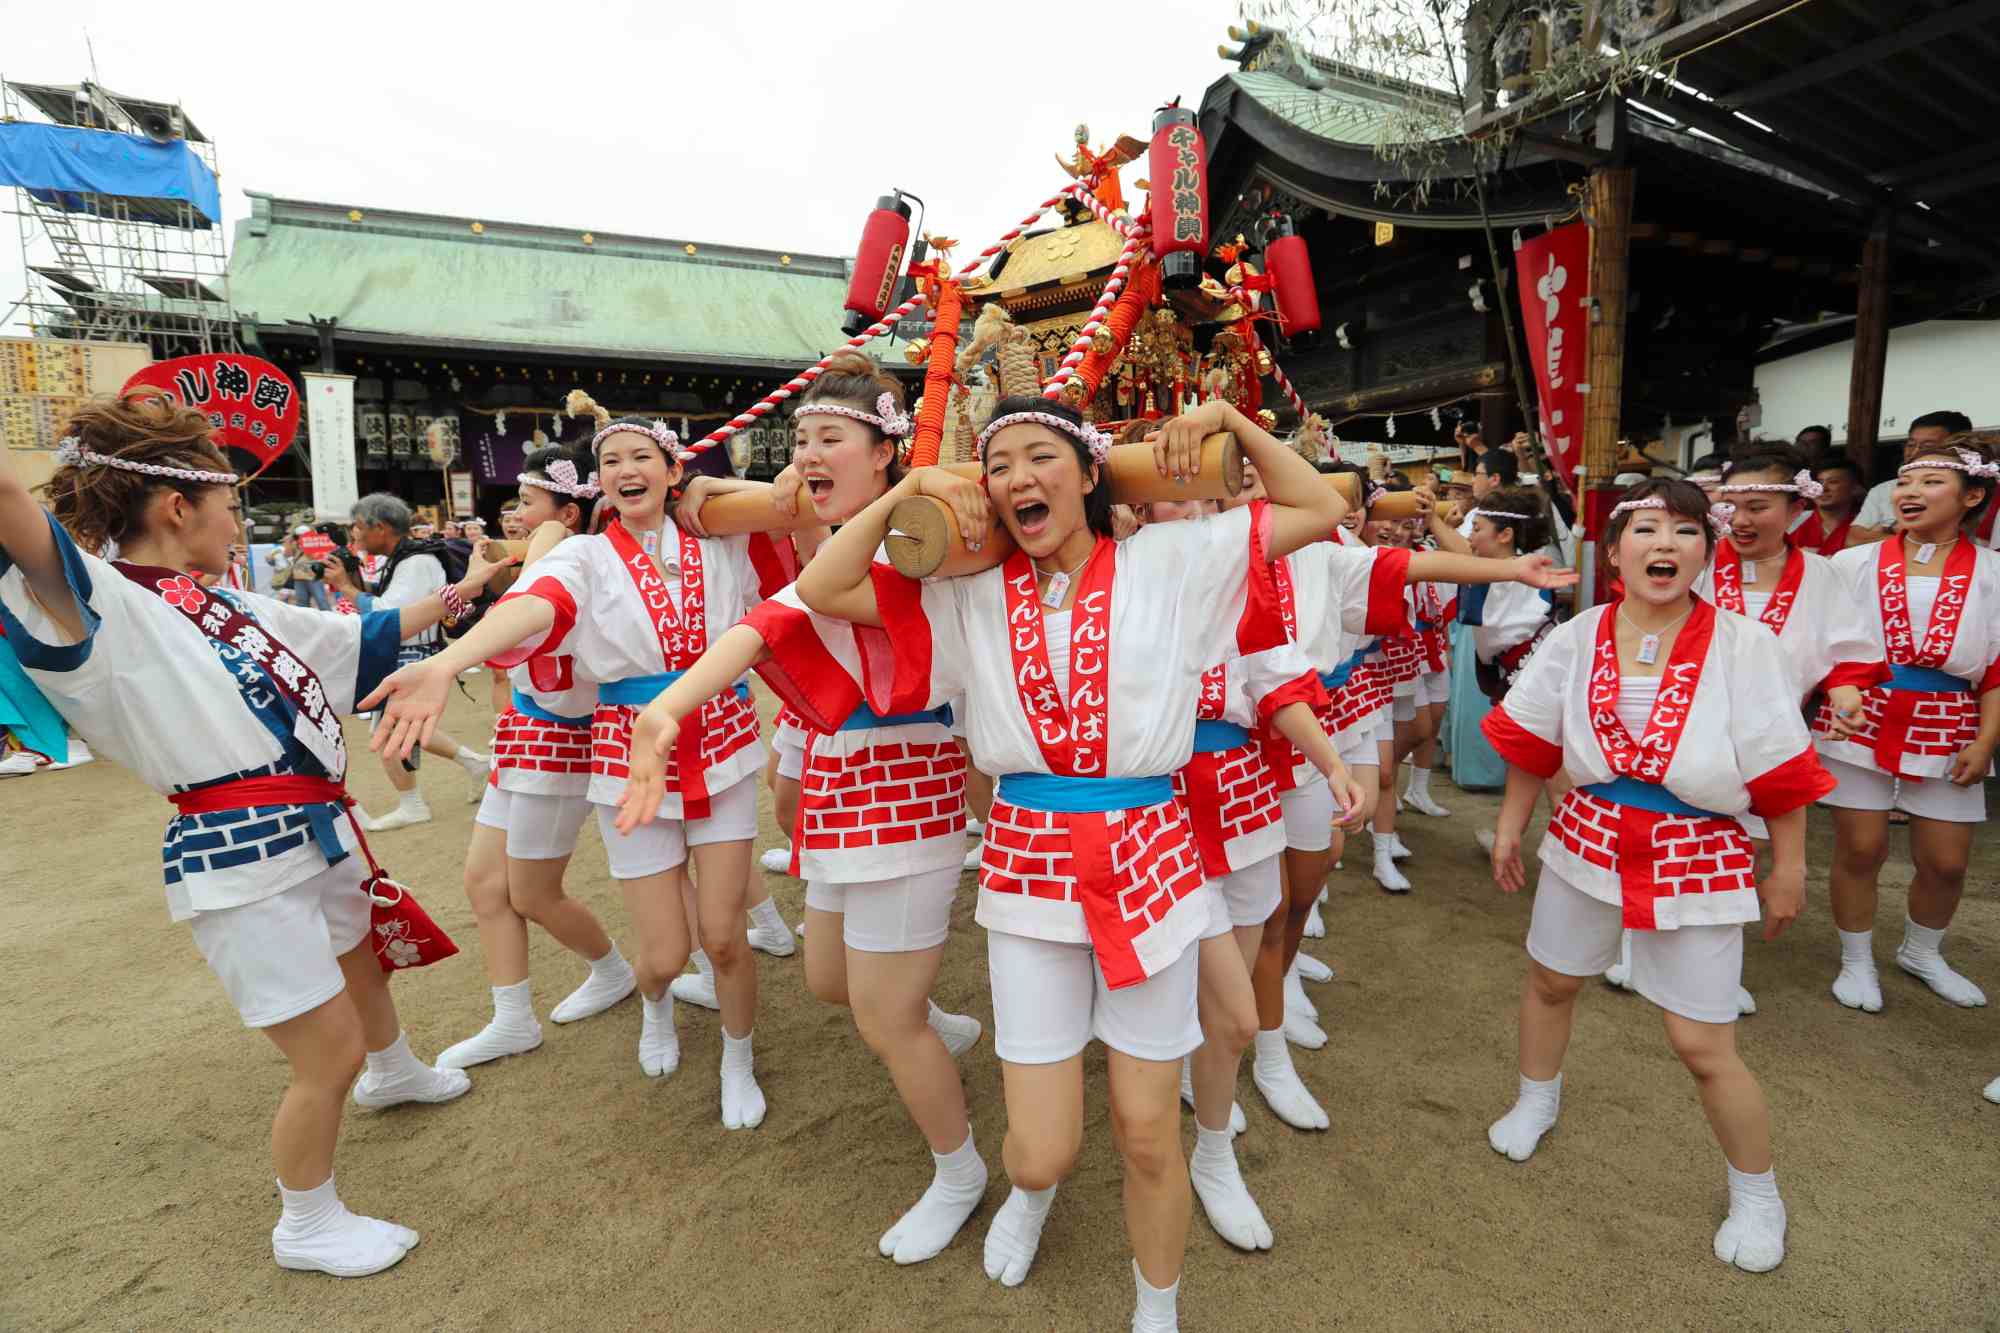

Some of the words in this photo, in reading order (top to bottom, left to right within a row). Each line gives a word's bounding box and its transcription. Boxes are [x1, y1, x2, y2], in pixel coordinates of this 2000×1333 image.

[1007, 572, 1067, 745] てんじんばし
[1070, 590, 1106, 774] てんじんばし
